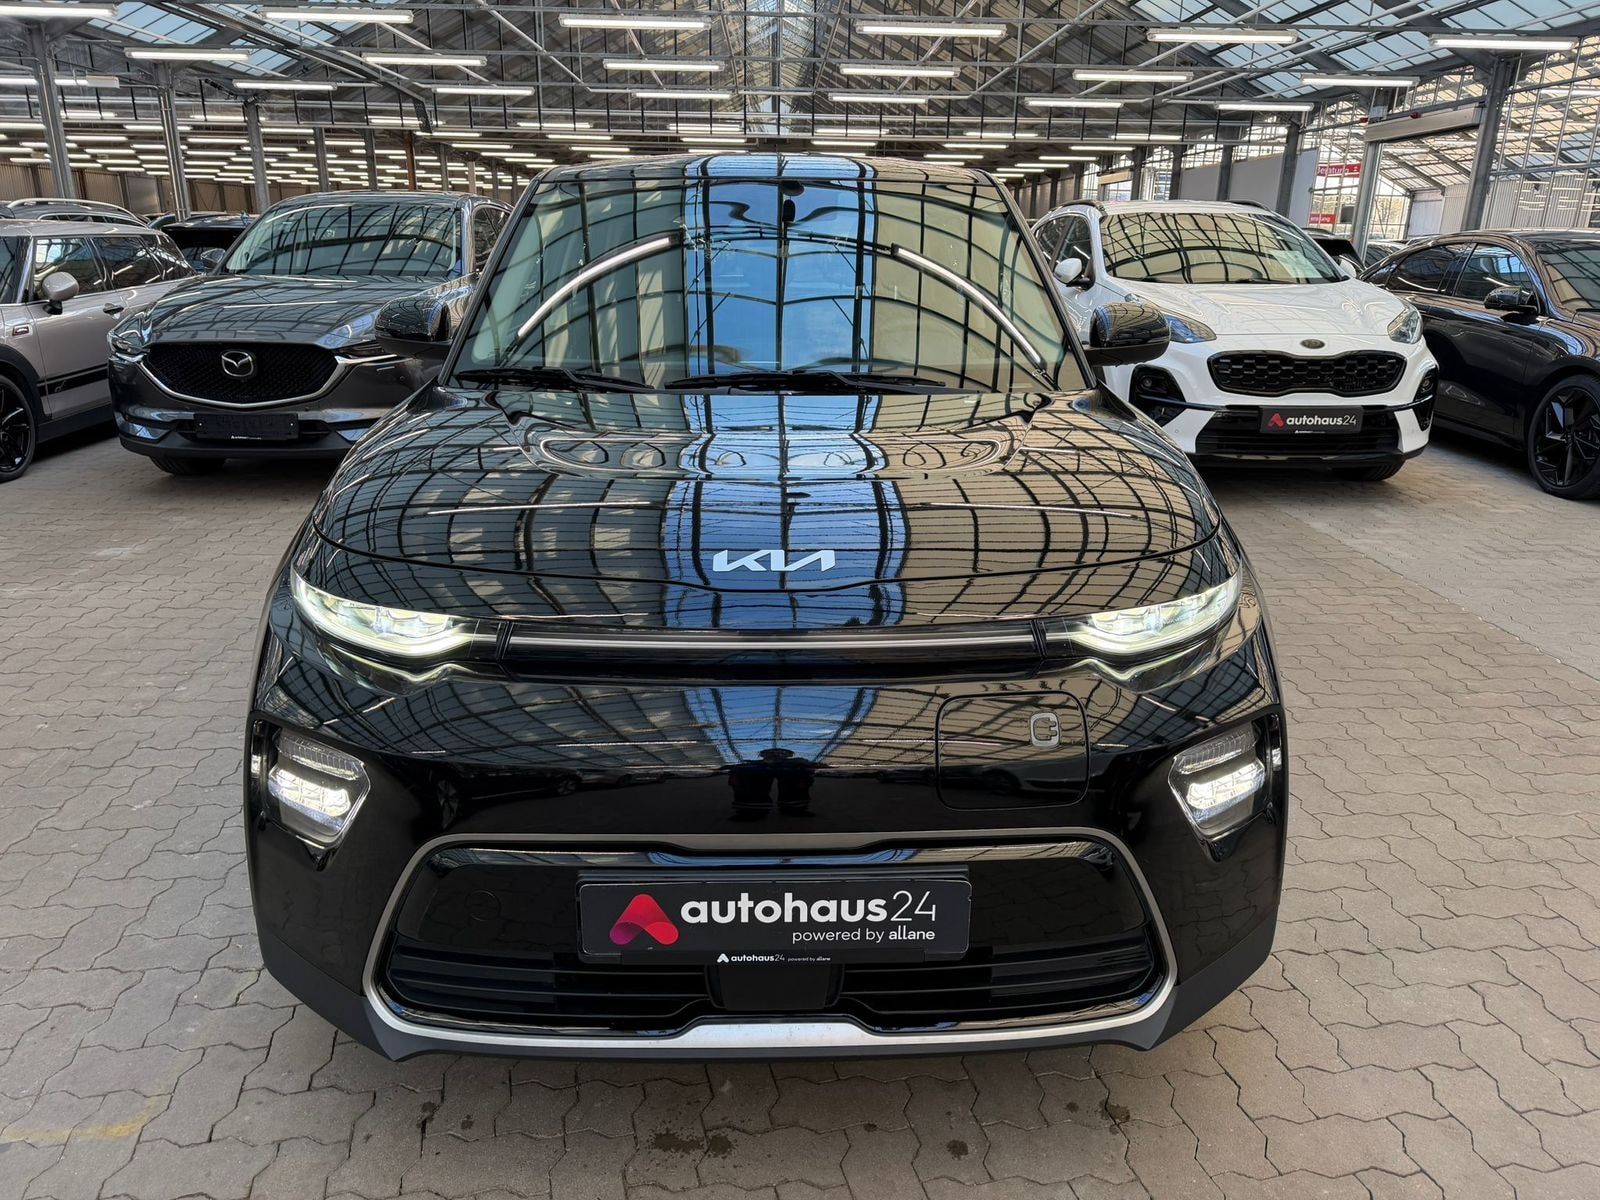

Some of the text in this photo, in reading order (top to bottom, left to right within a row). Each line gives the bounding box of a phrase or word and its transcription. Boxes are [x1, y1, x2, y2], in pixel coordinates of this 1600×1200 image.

[1286, 414, 1357, 426] autohaus24
[712, 549, 836, 572] KIA
[680, 890, 936, 924] autohaus24
[792, 925, 936, 944] powered by allane
[730, 953, 785, 962] autohaus24
